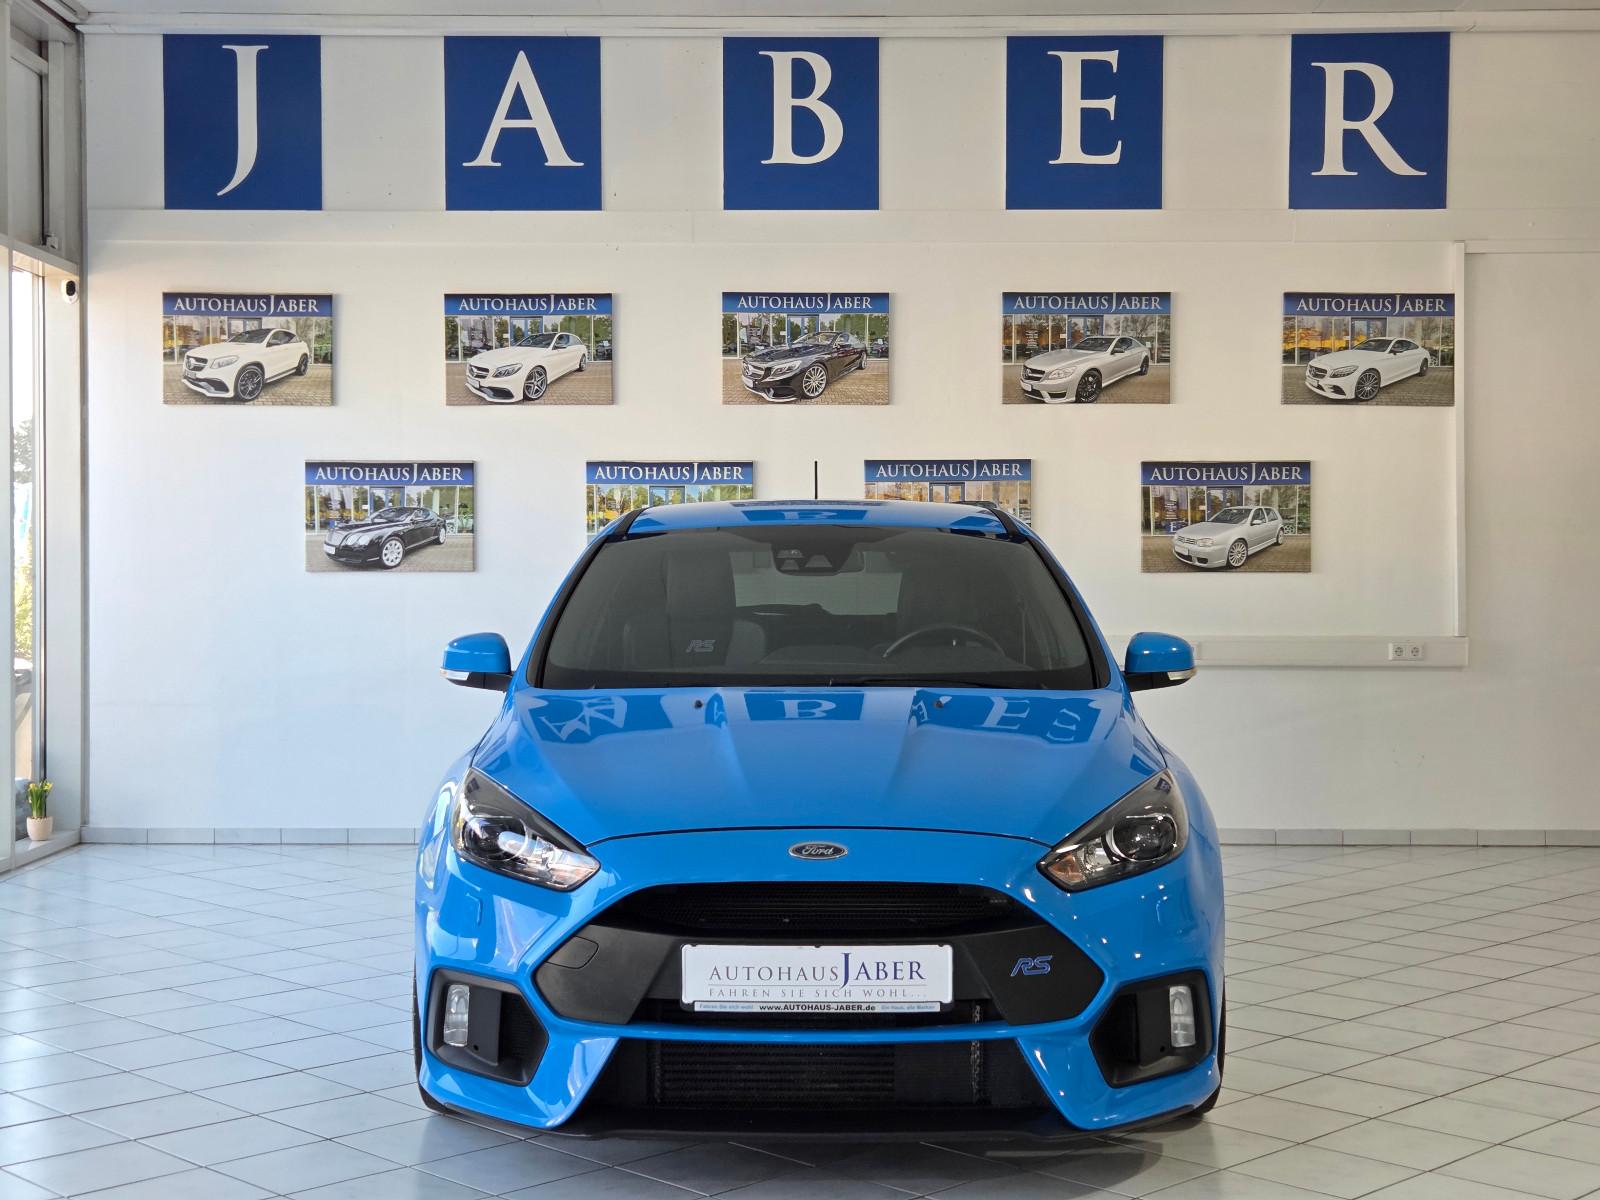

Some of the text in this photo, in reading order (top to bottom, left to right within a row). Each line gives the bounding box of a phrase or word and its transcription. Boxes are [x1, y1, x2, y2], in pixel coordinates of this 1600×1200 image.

[1010, 955, 1053, 977] RS
[709, 988, 770, 998] FAHREN
[781, 988, 805, 998] SIE
[815, 988, 852, 998] SICH
[759, 1003, 876, 1012] www.AUTOHAUS-JABER.de
